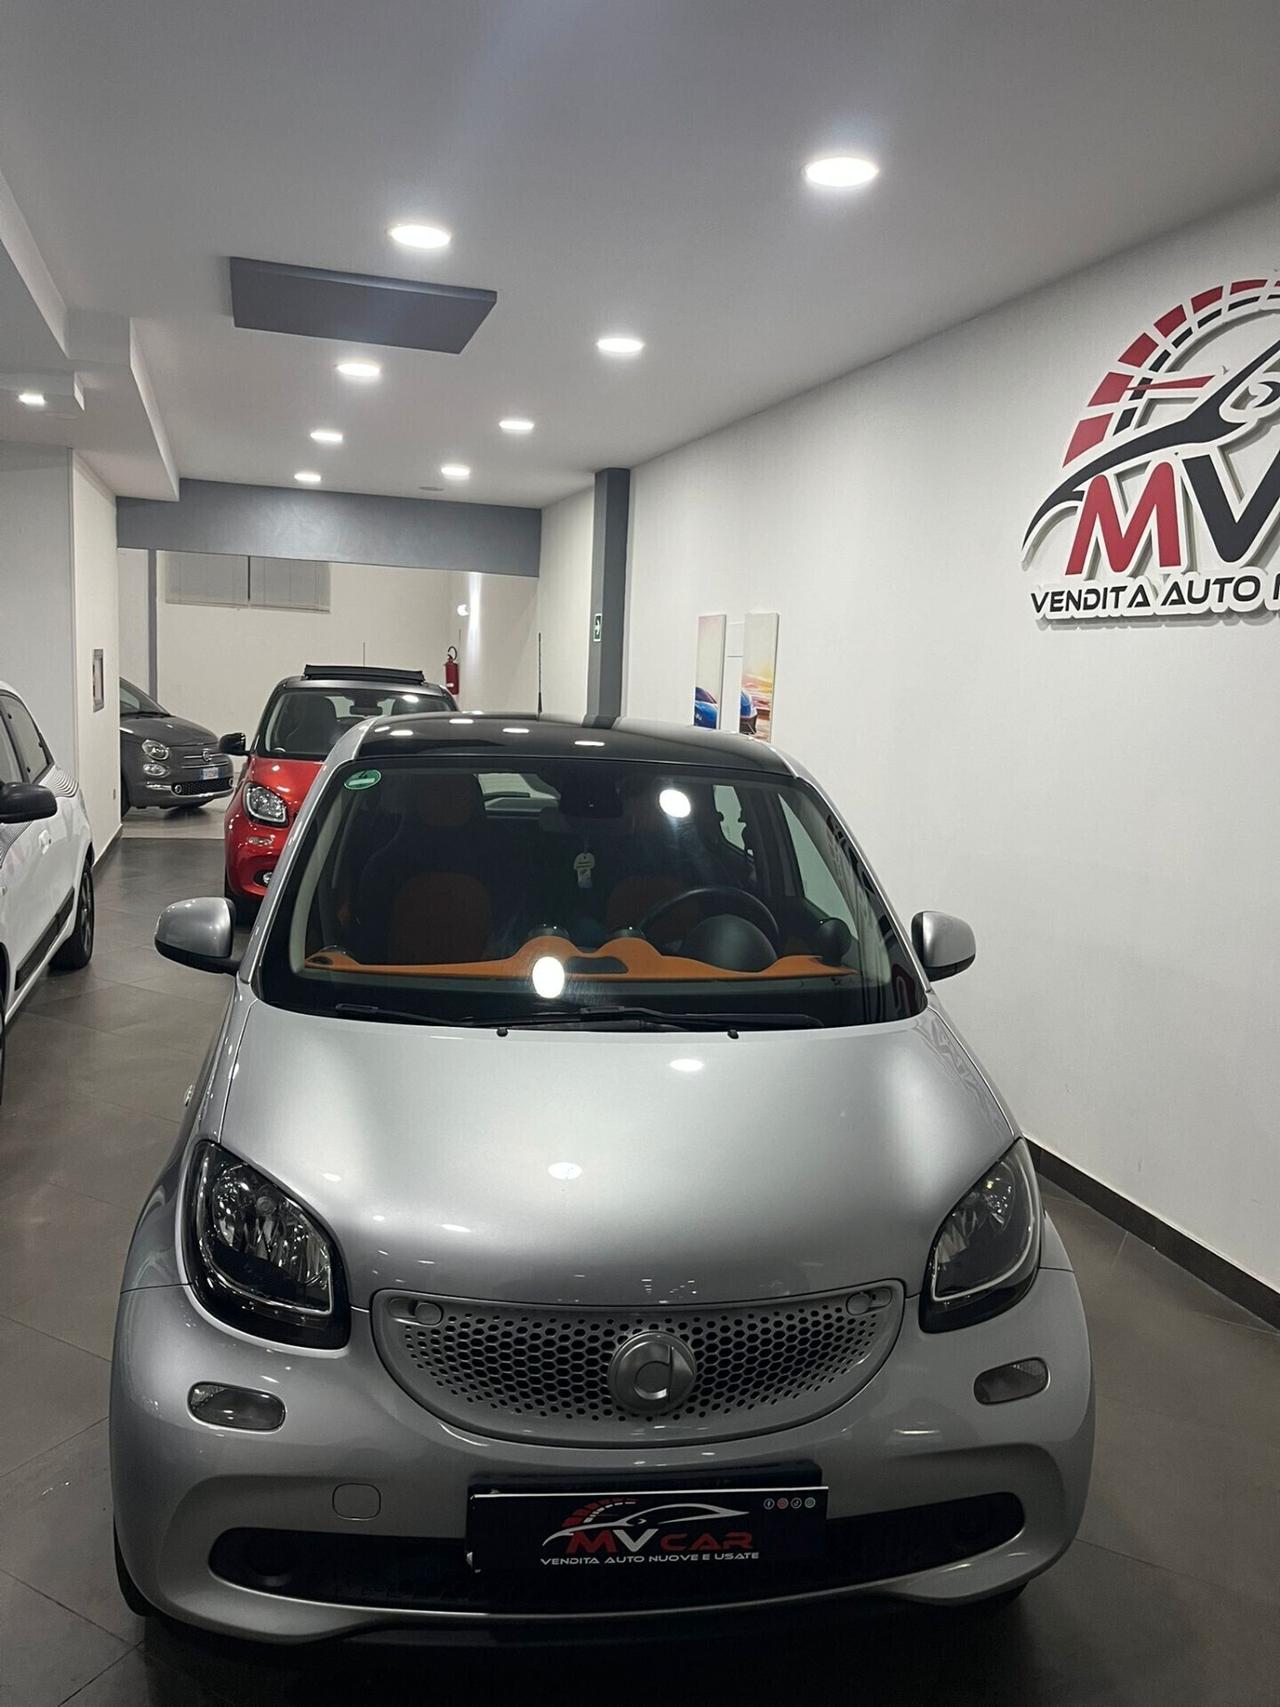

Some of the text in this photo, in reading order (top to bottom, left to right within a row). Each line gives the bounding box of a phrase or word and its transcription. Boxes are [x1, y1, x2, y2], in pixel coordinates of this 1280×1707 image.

[1030, 583, 1151, 613] VENDITA
[1160, 575, 1261, 606] AUTO
[540, 1551, 760, 1566] VENDITA AUTO NUOVE E USATE
